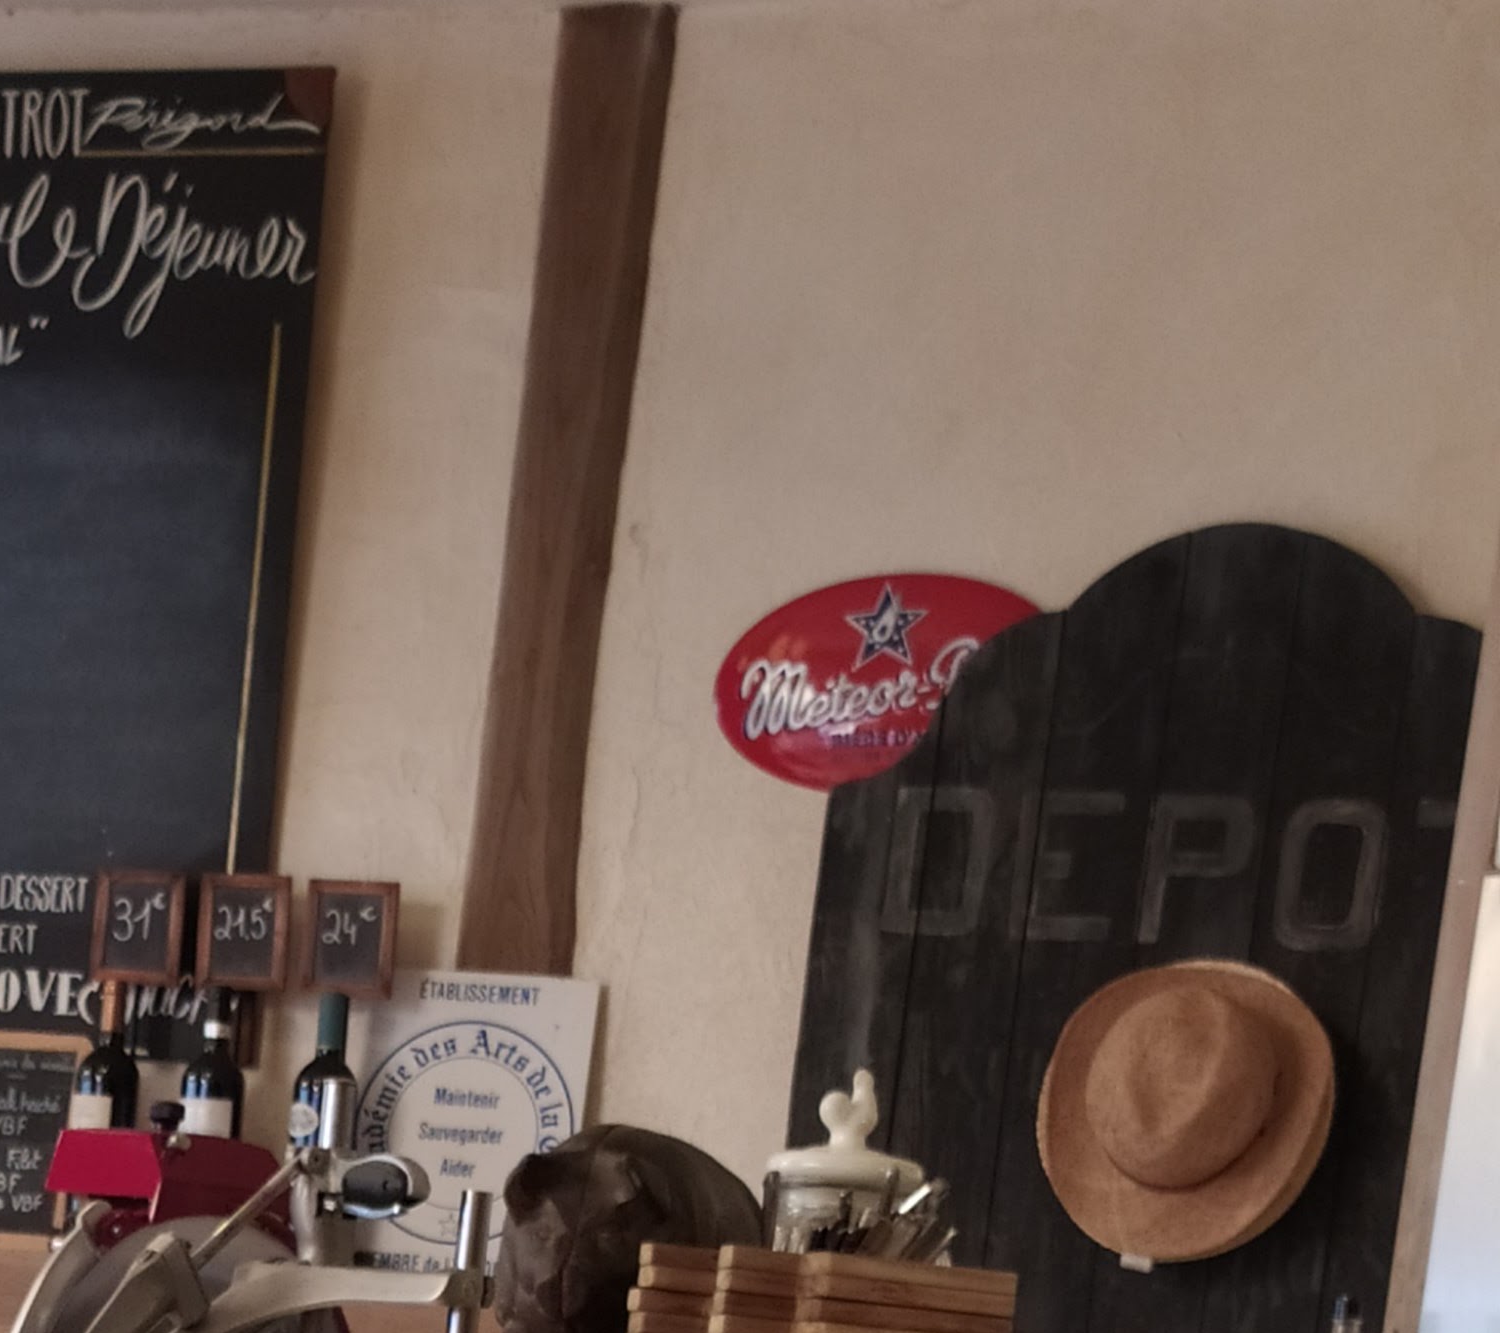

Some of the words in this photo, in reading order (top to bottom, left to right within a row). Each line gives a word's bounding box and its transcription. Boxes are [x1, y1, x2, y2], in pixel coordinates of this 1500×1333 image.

[72, 172, 316, 339] Déjeuner
[0, 873, 88, 914] DESSERT
[470, 1029, 530, 1073] Arts
[433, 1087, 500, 1110] Maintenir
